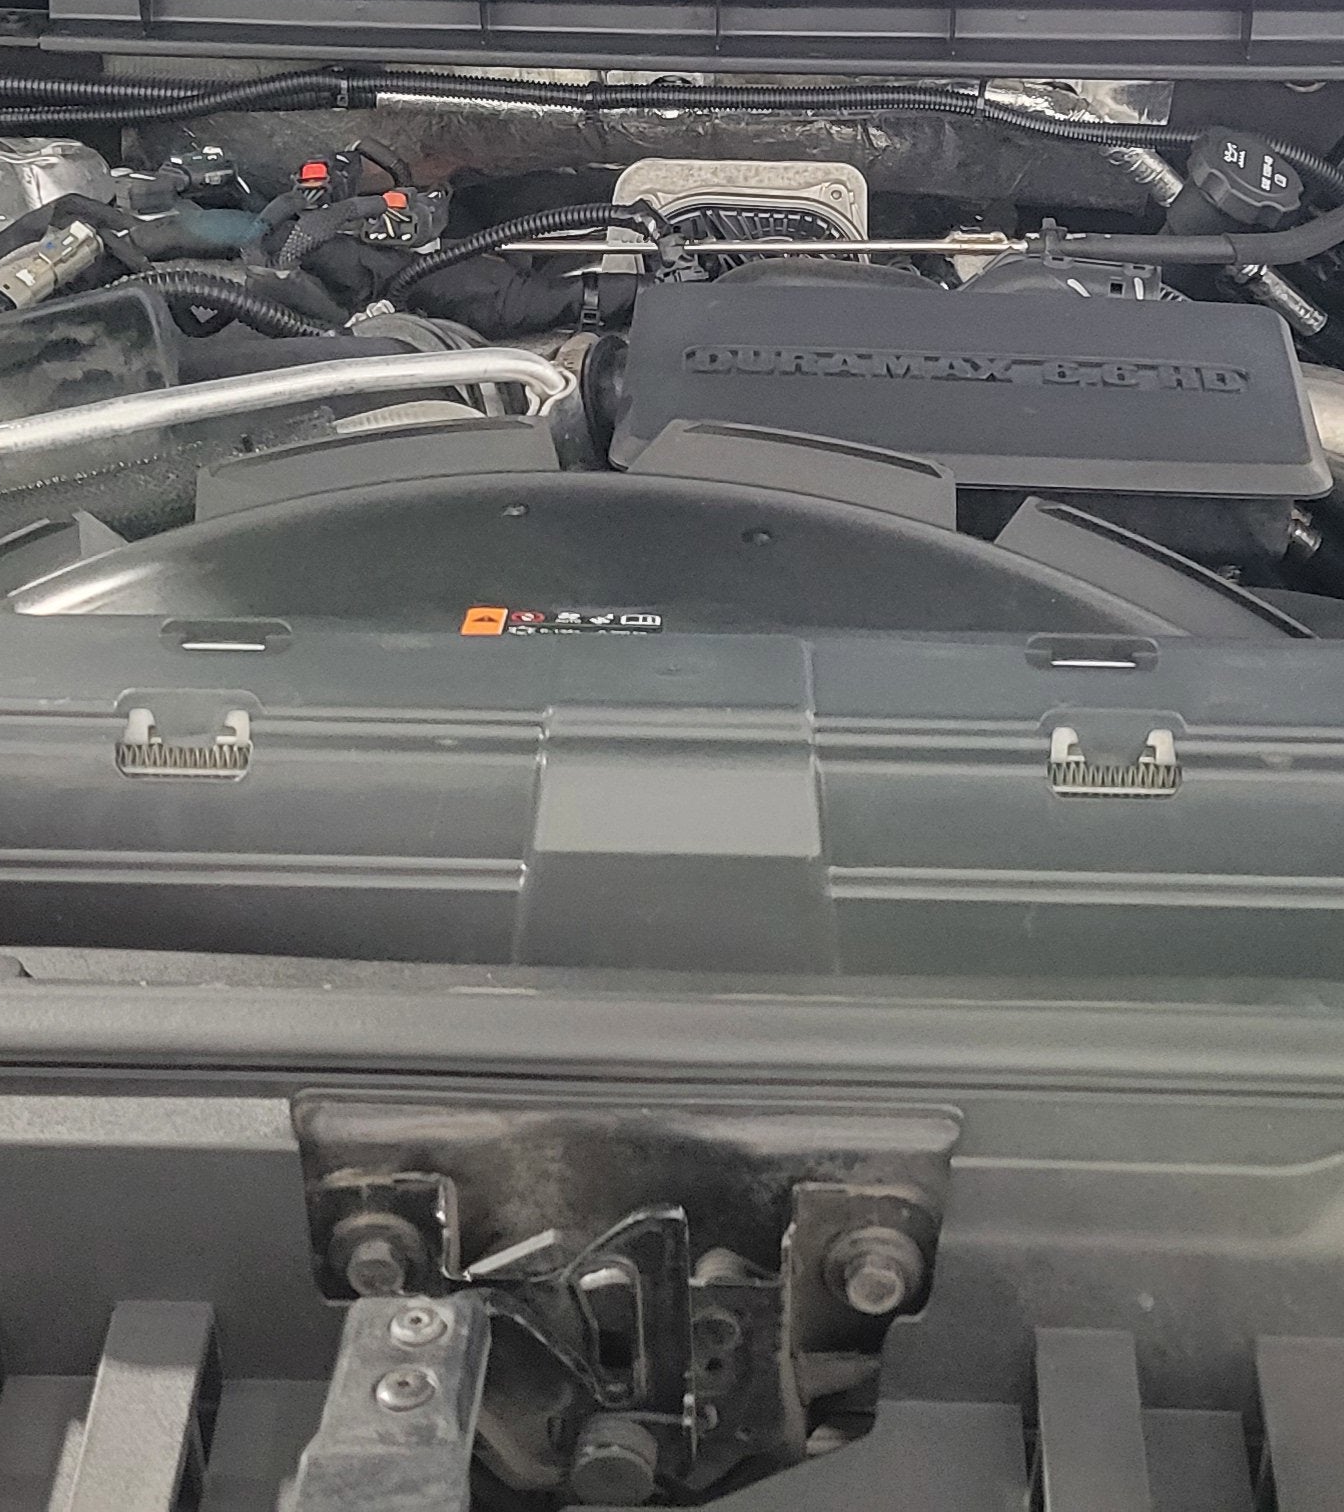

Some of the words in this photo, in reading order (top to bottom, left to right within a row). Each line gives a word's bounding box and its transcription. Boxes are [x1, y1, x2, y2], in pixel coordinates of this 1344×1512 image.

[689, 347, 1014, 383] DURAMAX
[1041, 358, 1140, 387] 6.6
[1155, 363, 1246, 393] HD
